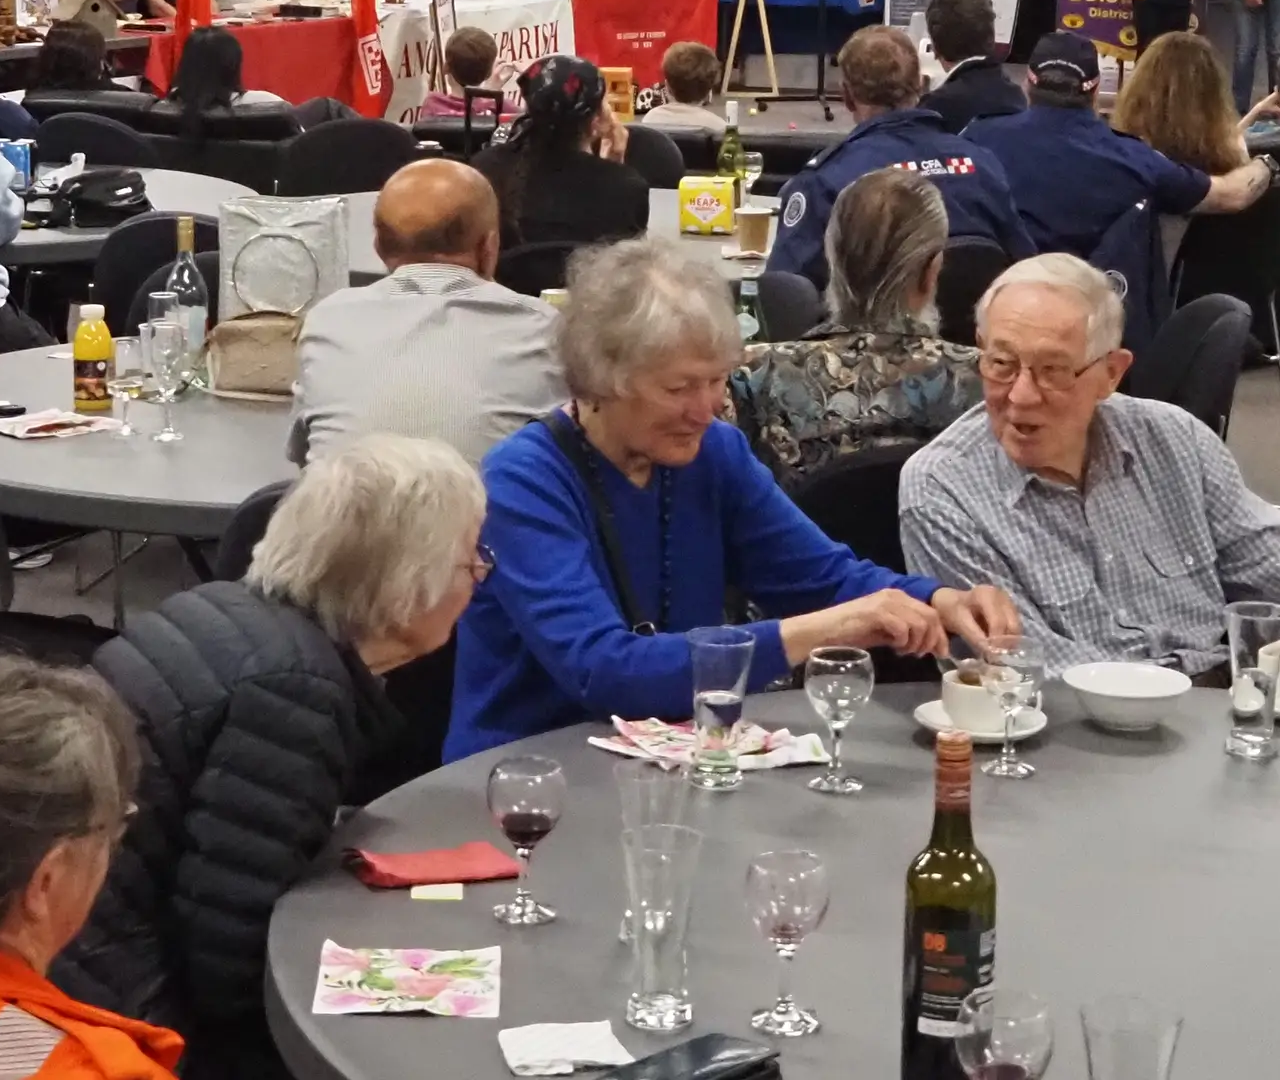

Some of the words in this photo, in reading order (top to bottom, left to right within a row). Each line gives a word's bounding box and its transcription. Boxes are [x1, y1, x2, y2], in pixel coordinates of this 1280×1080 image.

[498, 19, 559, 63] PARISH
[921, 158, 943, 170] CFA
[689, 197, 721, 207] HEAPS
